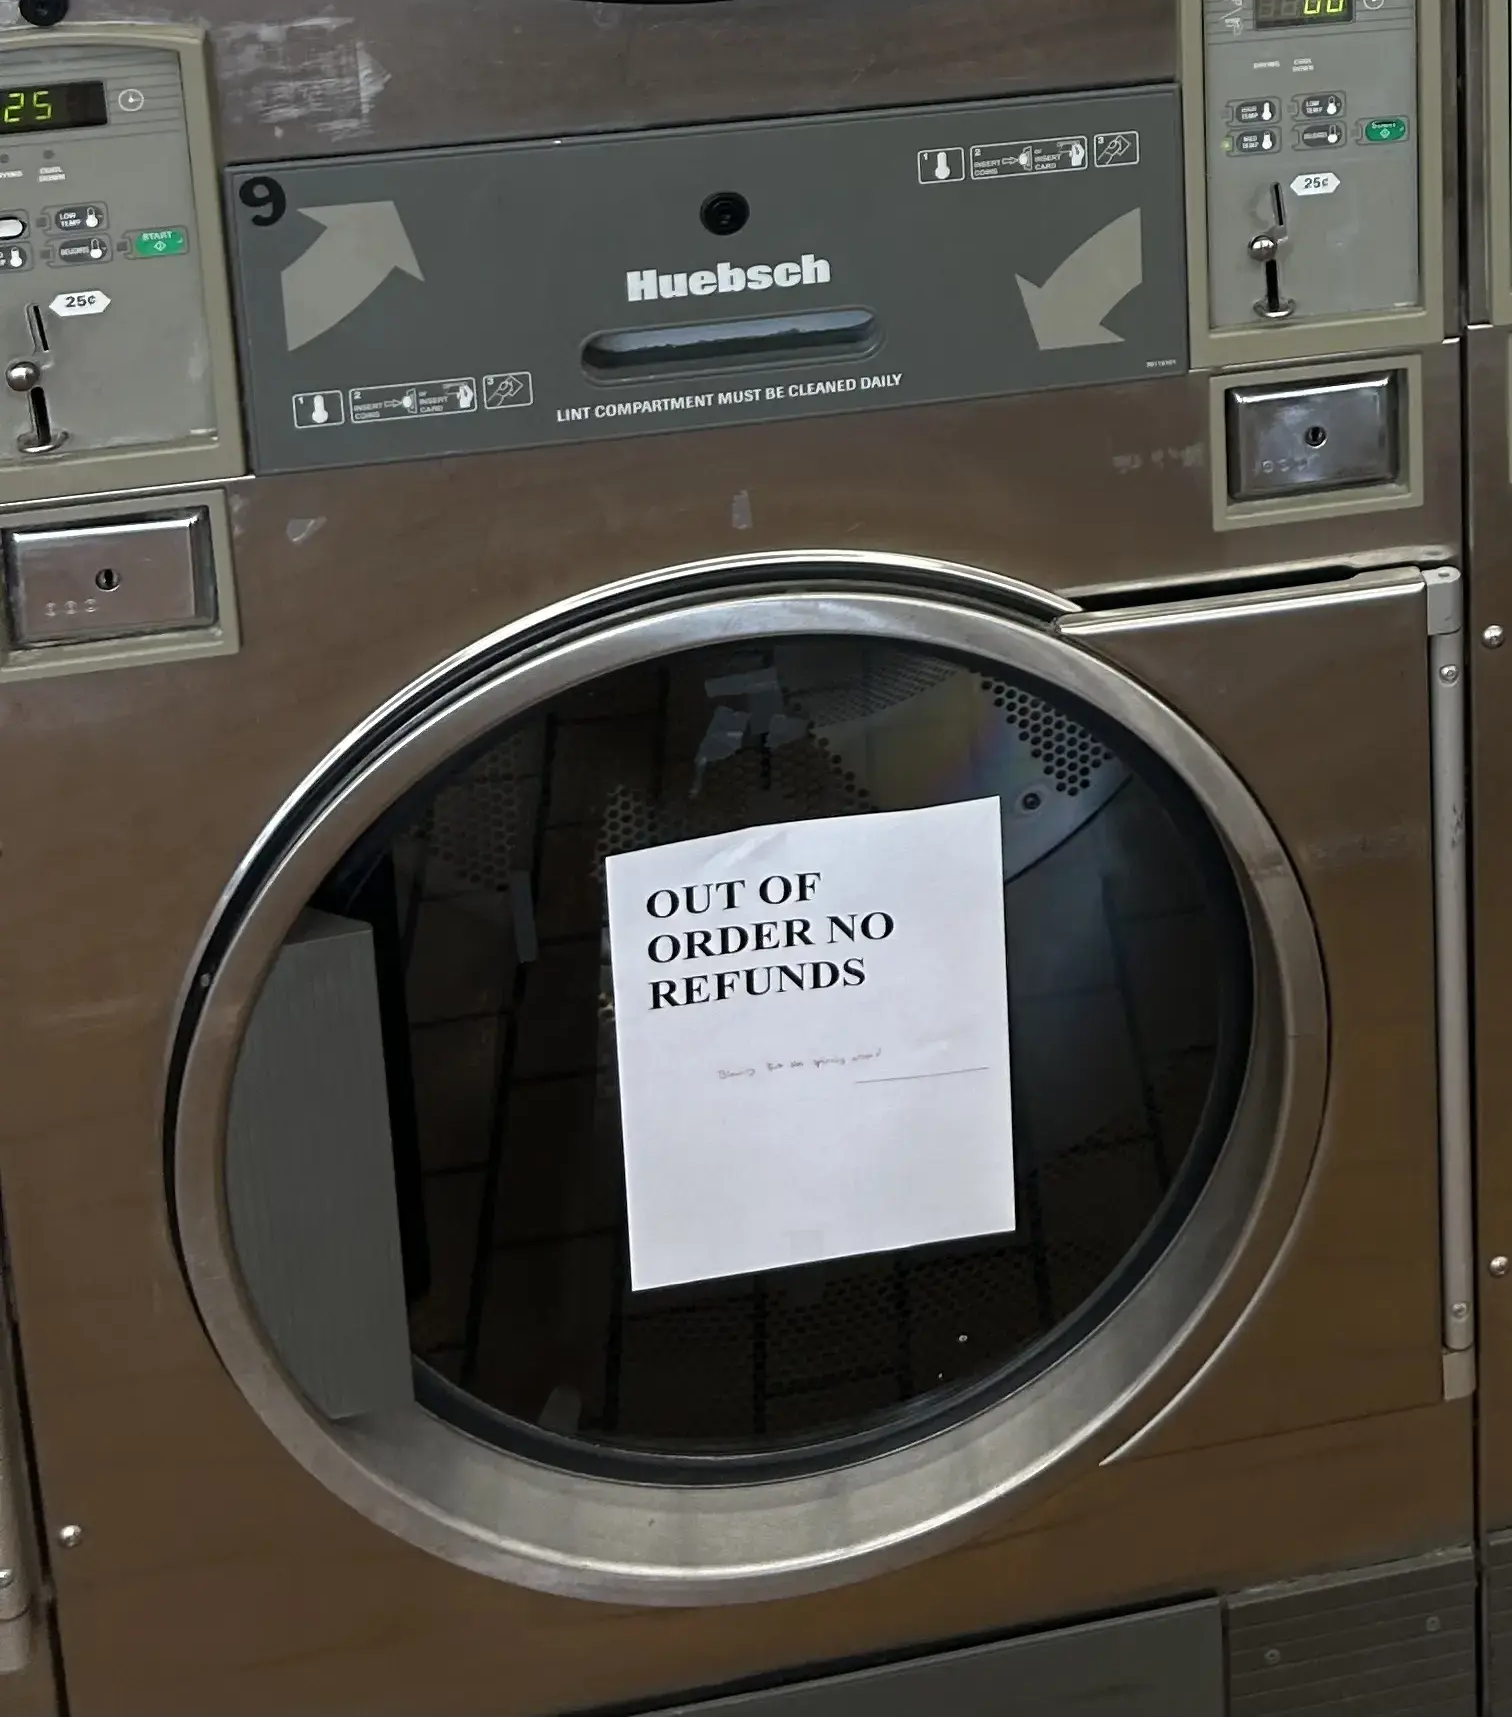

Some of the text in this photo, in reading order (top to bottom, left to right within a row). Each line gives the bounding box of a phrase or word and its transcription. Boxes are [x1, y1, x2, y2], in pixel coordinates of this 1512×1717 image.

[4, 90, 52, 124] 25
[239, 176, 286, 226] 9
[1304, 177, 1329, 190] 25¢
[142, 232, 172, 240] START
[65, 295, 96, 308] 25¢
[626, 253, 831, 302] Huebsch
[557, 373, 902, 422] LINT COMPARTMENT MUST BE CLEANED DAILY
[646, 872, 821, 919] OUT OF
[647, 911, 894, 964] ORDER NO
[649, 958, 866, 1010] REFUNDS
